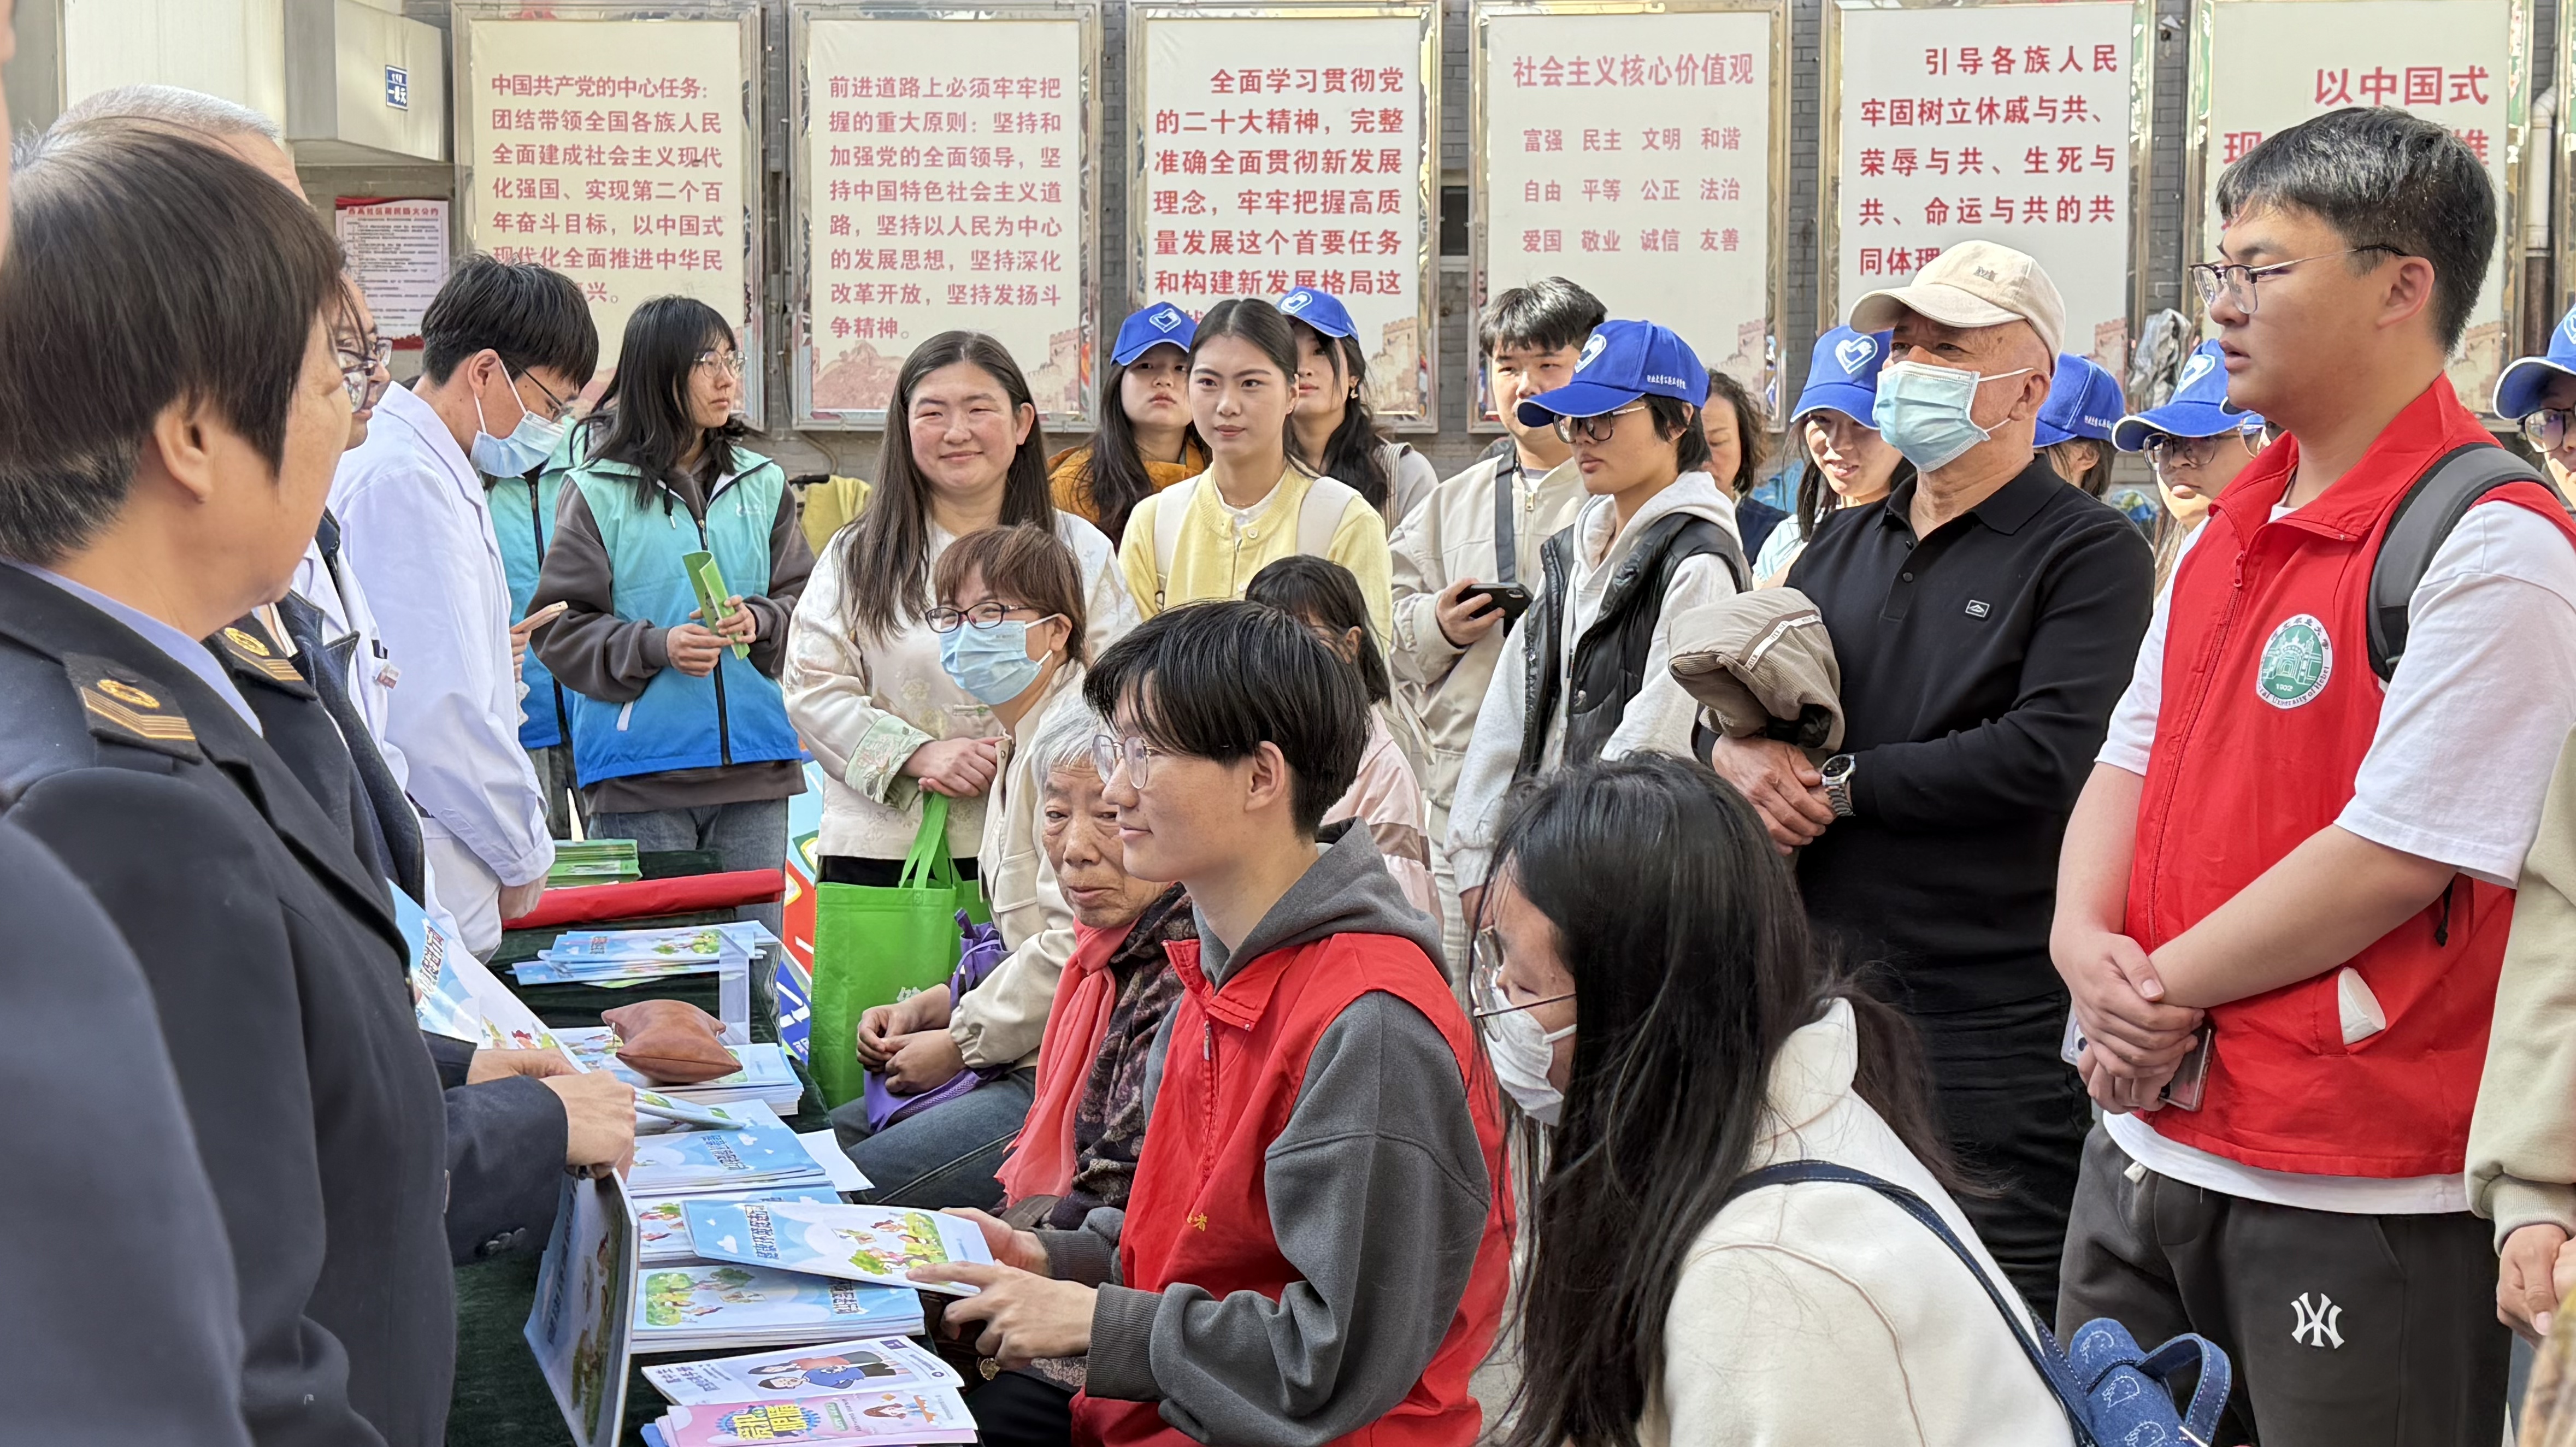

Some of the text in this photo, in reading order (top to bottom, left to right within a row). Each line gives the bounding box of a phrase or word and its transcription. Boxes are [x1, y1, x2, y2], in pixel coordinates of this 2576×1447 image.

[1514, 54, 1753, 87] 社会主义核心价值观
[1925, 43, 2119, 76] 引导各族人民
[492, 74, 708, 99] 中国共产党的中心任务：
[831, 76, 1060, 98] 前进道路上必须牢牢把
[1211, 67, 1404, 95] 全面学习贯彻党
[2314, 65, 2489, 106] 以中国式
[492, 109, 720, 133] 团结带领全国各族人民
[830, 111, 1060, 133] 握的重大原则：坚持和
[1155, 107, 1404, 136] 的二十大精神，完整
[1861, 95, 2103, 127] 牢固树立休戚与共、
[1522, 127, 1741, 153] 富强 民主 文明 和谐
[493, 143, 722, 168] 全面建成社会主义现代
[831, 146, 1059, 168] 加强党的全面领导，坚
[1156, 149, 1401, 175] 准确全面贯彻新发展
[1860, 144, 2117, 178] 荣辱与共、生死与
[493, 178, 720, 202] 化强国、实现第二个百
[830, 180, 1060, 203] 持中国特色社会主义道
[1154, 188, 1400, 216] 理念，牢牢把握高质
[1523, 178, 1742, 203] 自由 平等 公正 法治
[1859, 194, 2116, 227] 共、命运与共的共
[493, 211, 723, 237] 年奋斗目标，以中国式
[830, 214, 1062, 238] 路，坚持以人民为中心
[1157, 229, 1401, 256] 量发展这个首要任务
[1522, 227, 1740, 253] 爱国 敬业 诚信 友善
[831, 250, 1058, 271] 的发展思想，坚持深化
[831, 282, 1058, 305] 改革开放，坚持发扬斗
[832, 317, 909, 340] 争精神。
